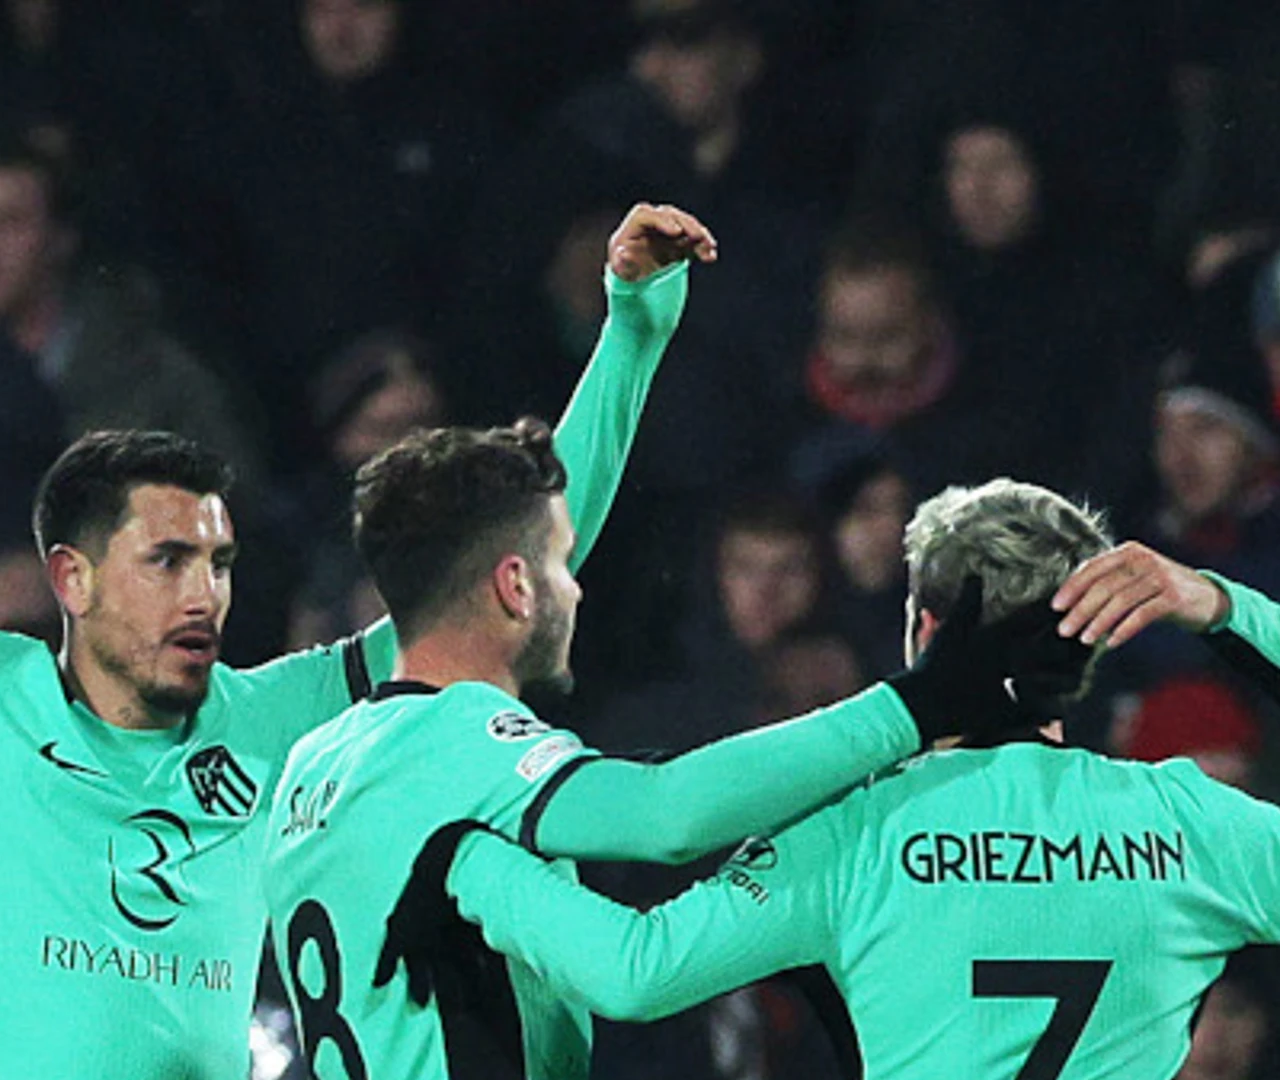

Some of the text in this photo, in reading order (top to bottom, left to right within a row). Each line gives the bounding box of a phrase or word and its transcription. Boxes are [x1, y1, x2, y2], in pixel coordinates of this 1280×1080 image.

[901, 831, 1186, 884] GRIEZMANN
[42, 936, 232, 992] RIYADH AIR
